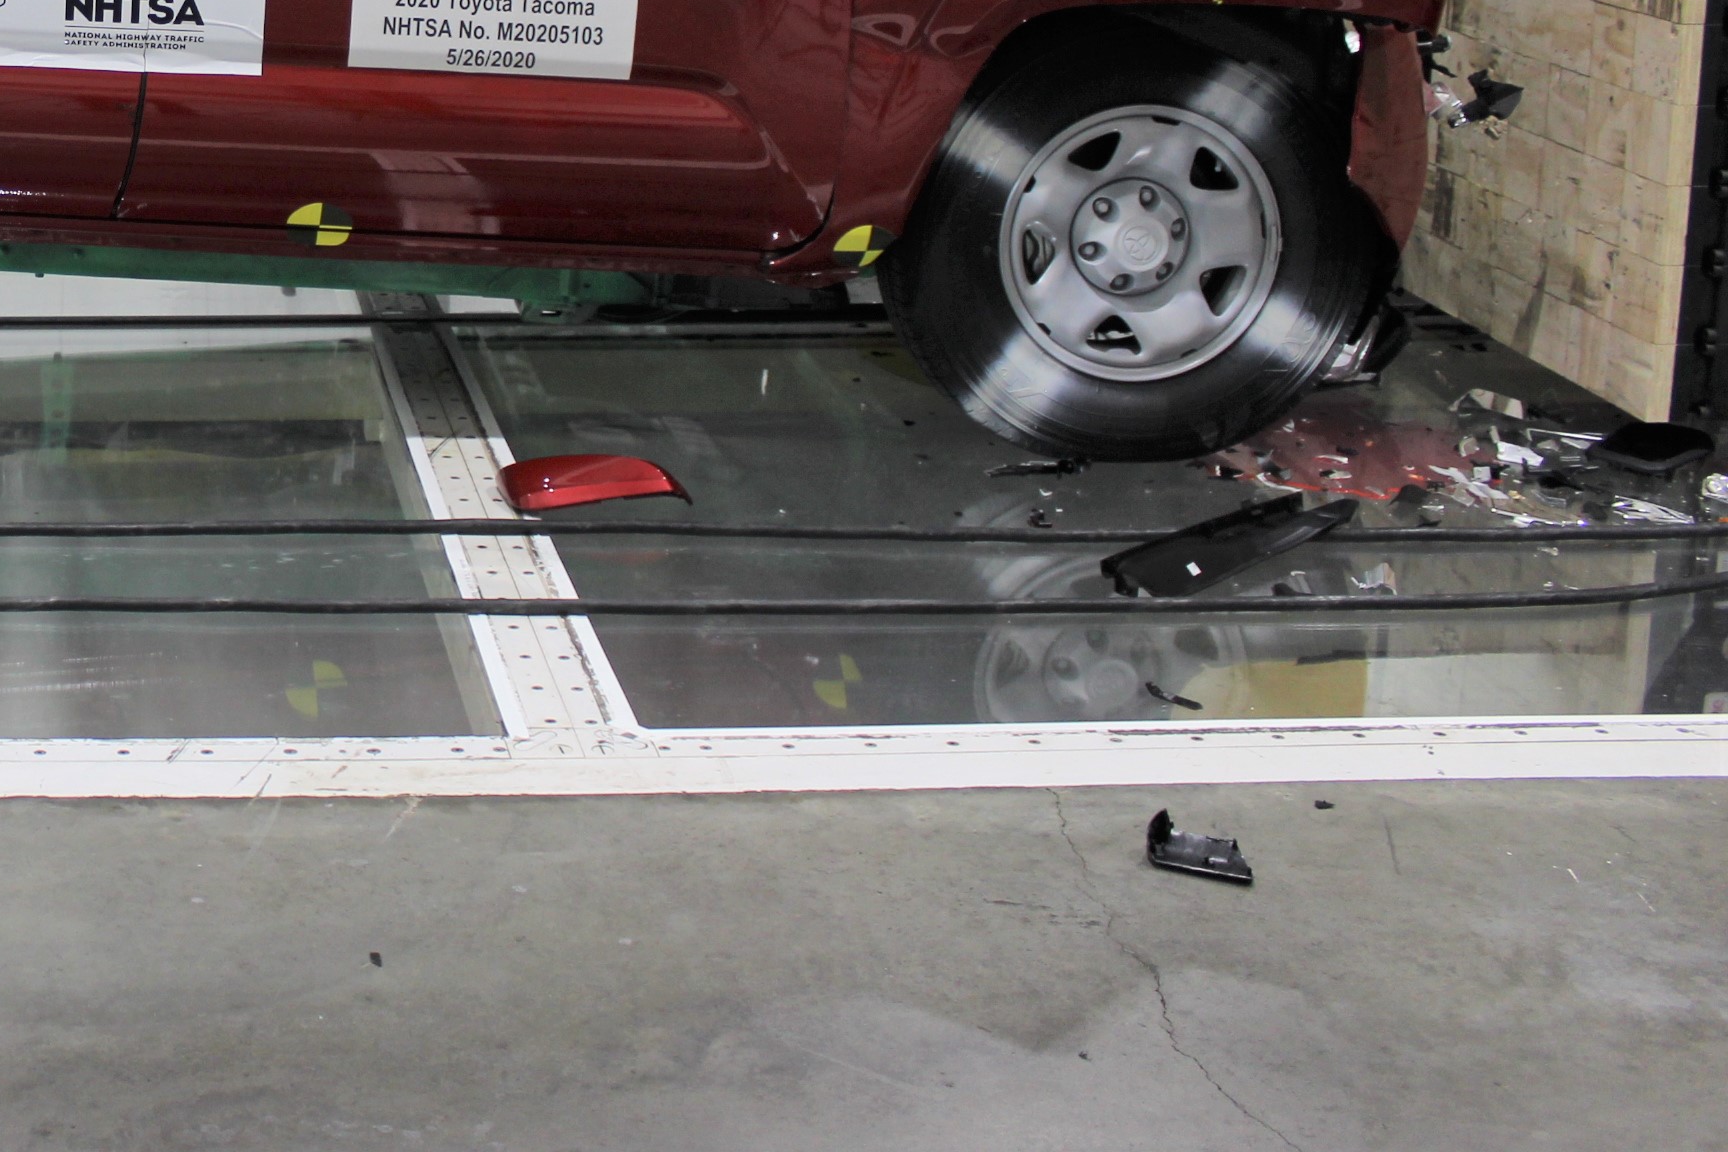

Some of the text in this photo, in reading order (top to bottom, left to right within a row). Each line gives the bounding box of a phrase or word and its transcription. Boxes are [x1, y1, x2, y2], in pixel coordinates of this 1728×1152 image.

[64, 31, 205, 43] NATIONAL HIGHWAY TRAFFIC
[383, 16, 604, 46] NHTSA No. M20205103
[102, 41, 186, 50] ADMINISTRATION
[446, 48, 536, 69] 5/26/2020
